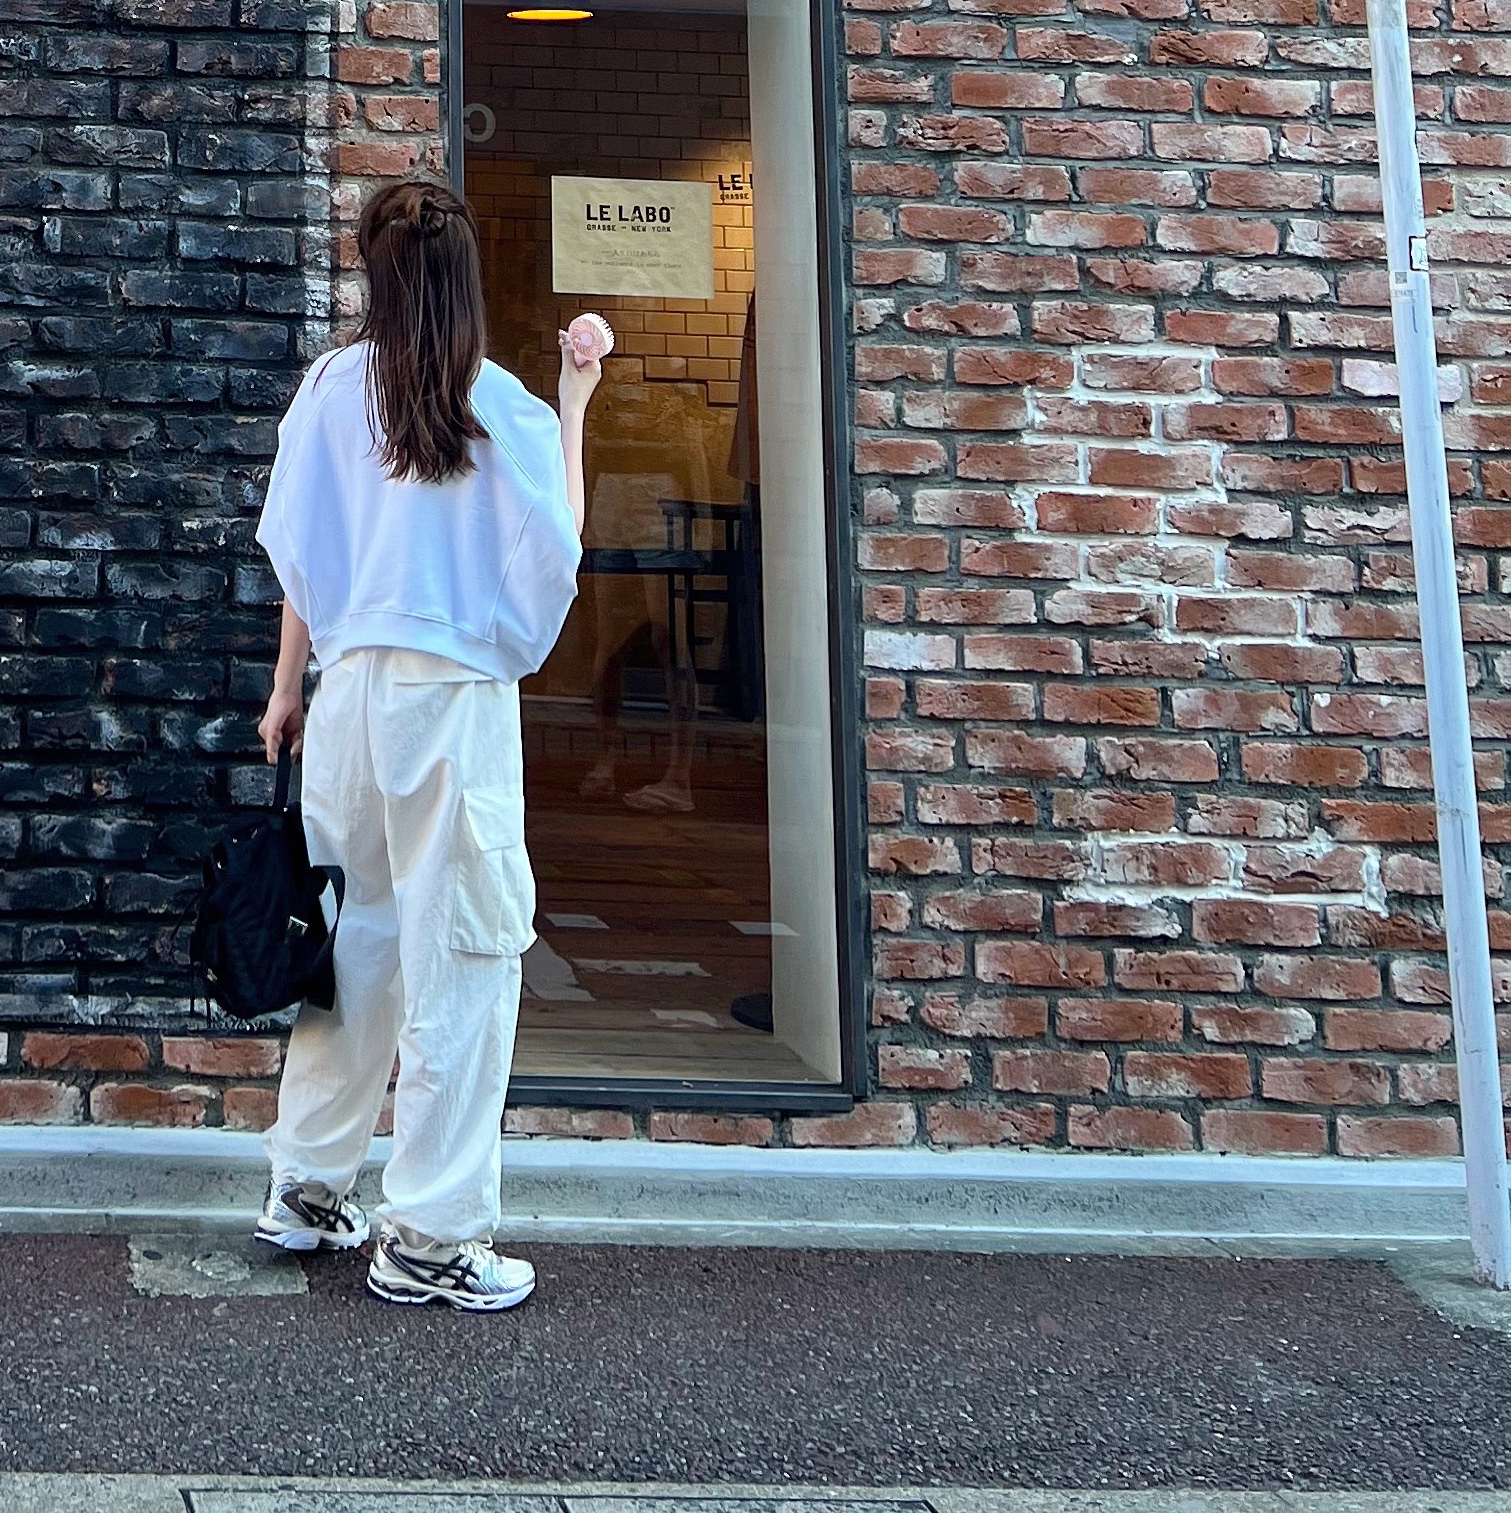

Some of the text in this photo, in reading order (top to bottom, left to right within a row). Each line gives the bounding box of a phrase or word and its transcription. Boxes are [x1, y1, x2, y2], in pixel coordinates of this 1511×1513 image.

[718, 173, 744, 191] LE
[586, 203, 672, 224] LE LABO
[631, 224, 649, 233] NEW
[651, 224, 672, 233] YORK
